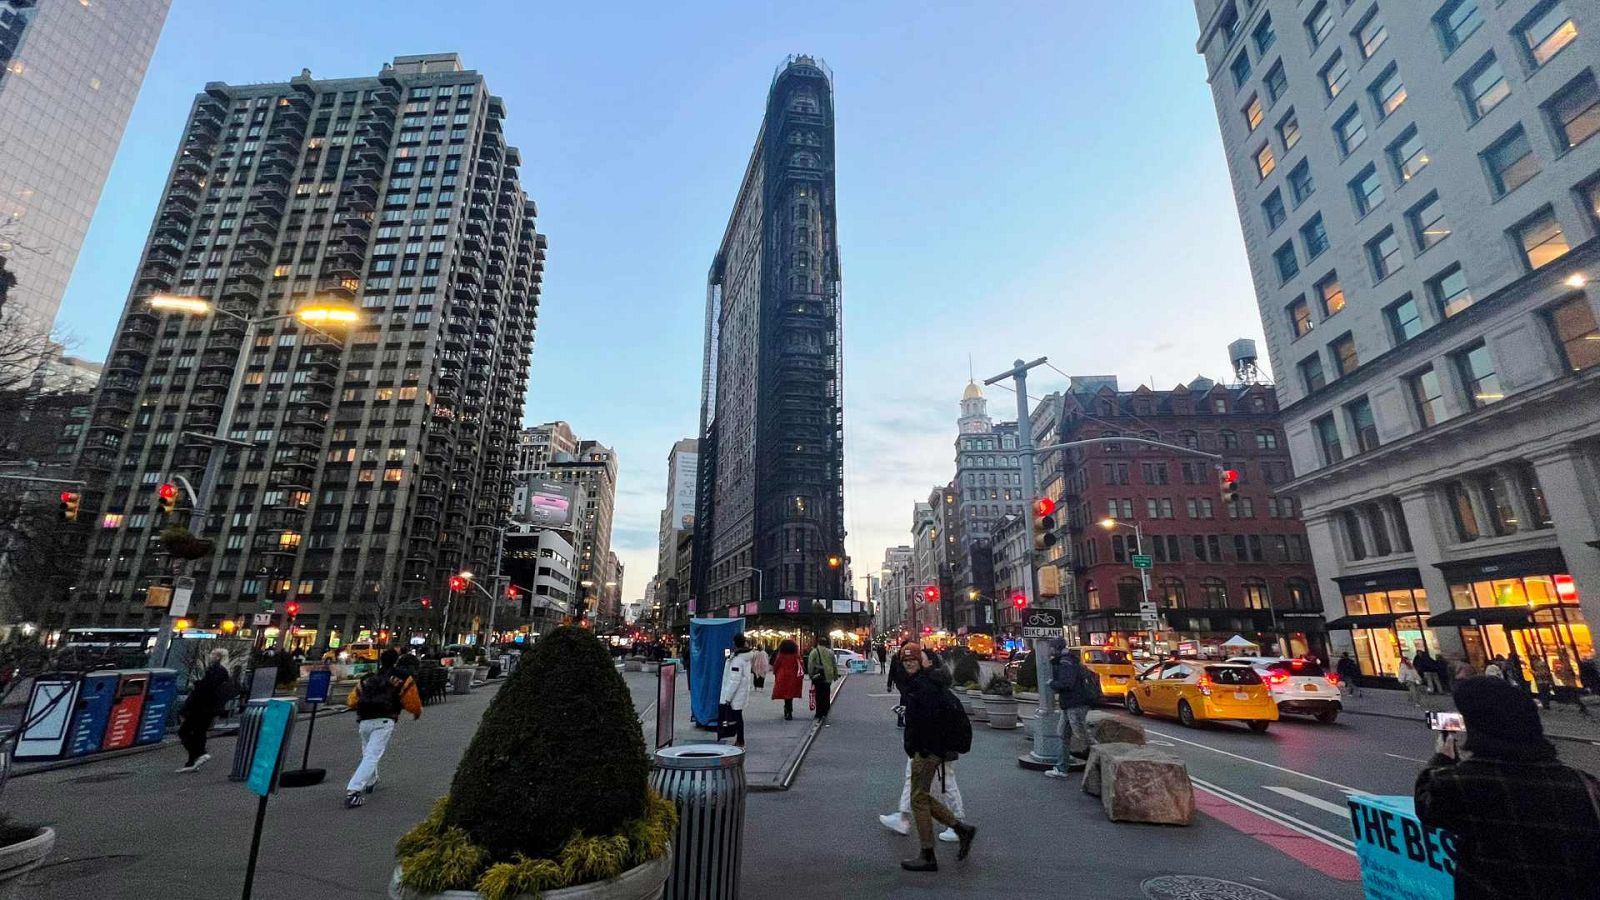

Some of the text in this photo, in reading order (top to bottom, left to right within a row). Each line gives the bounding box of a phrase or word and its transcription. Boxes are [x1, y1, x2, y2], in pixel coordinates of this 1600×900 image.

[1024, 628, 1062, 637] BIKE LANE
[1347, 800, 1401, 855] THE
